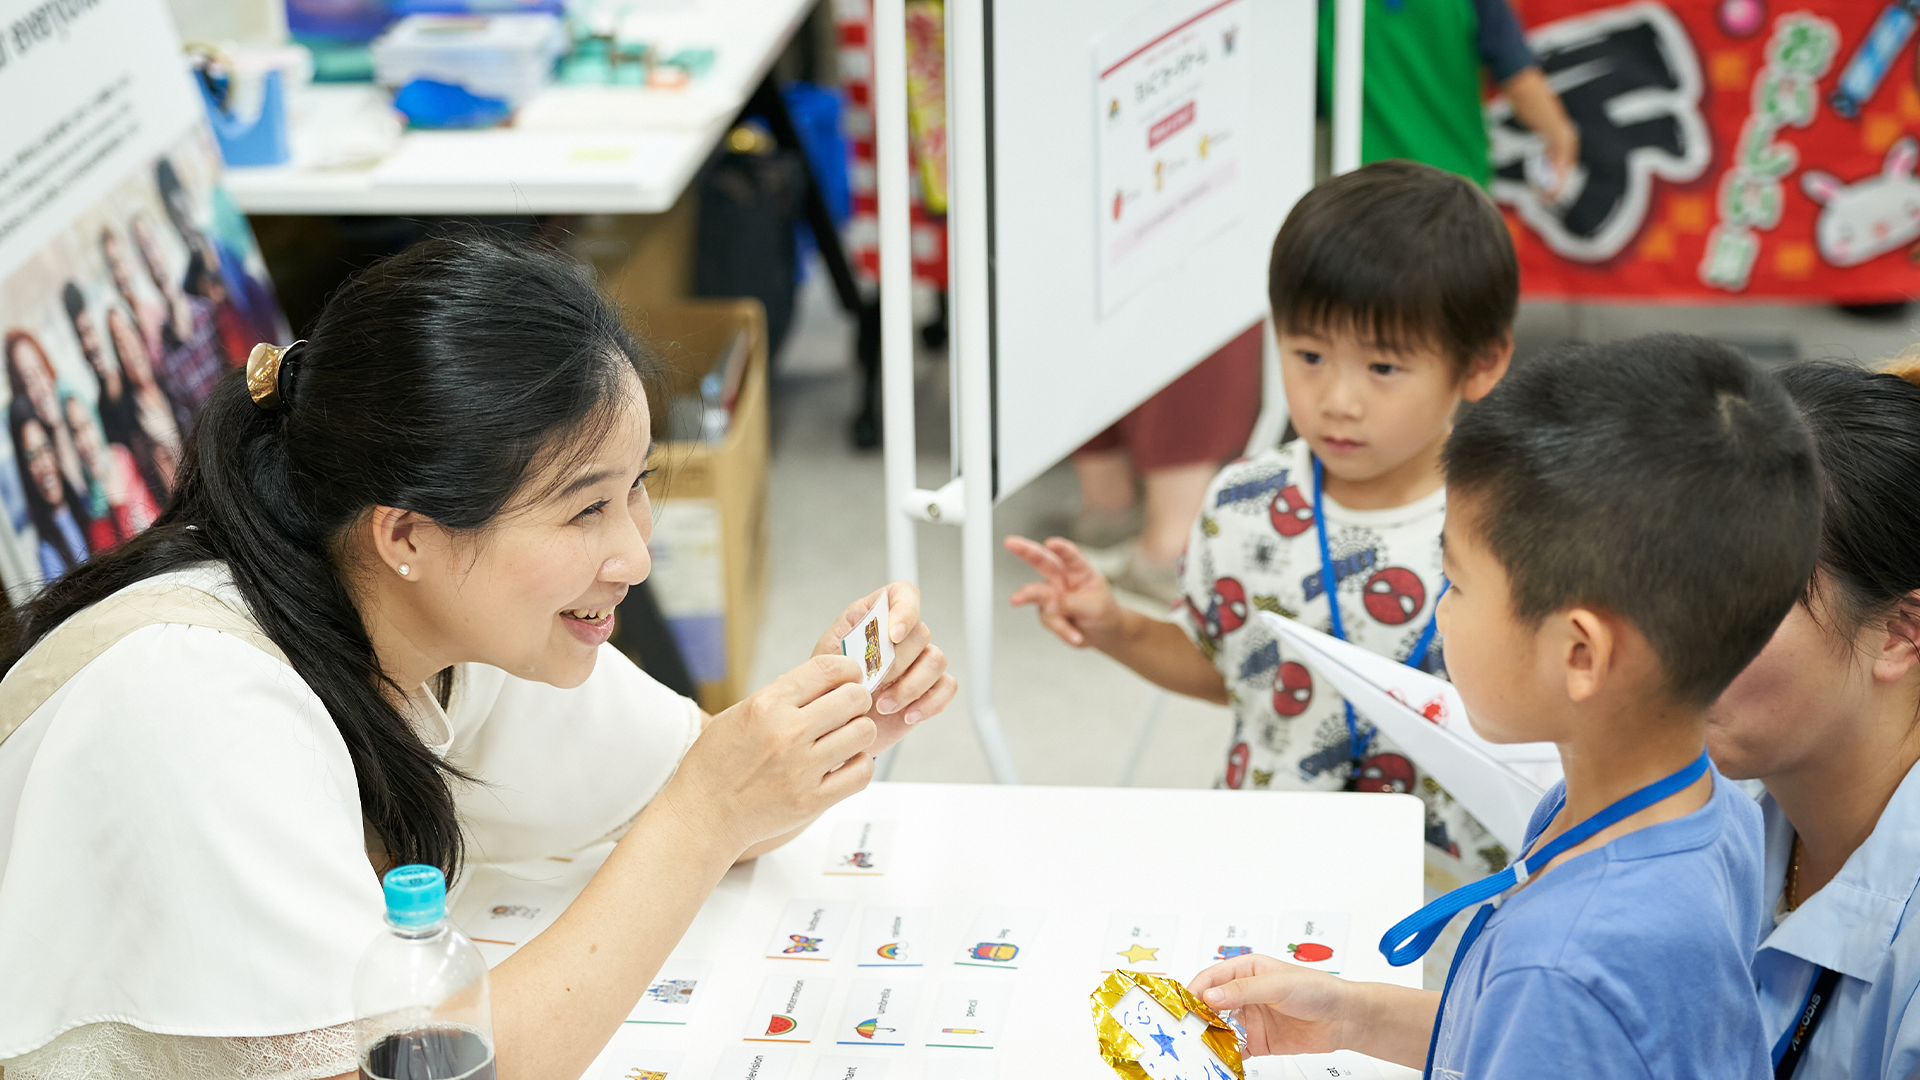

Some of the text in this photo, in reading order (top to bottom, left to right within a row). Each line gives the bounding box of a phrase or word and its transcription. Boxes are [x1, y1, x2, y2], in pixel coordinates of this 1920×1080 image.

[785, 979, 805, 1014] watermelon
[877, 987, 892, 1015] umbrella
[966, 999, 978, 1017] pencil
[1792, 993, 1822, 1052] AKKODIS
[745, 1055, 764, 1080] elevision
[842, 1066, 858, 1080] hant
[1325, 1066, 1340, 1078] cat
